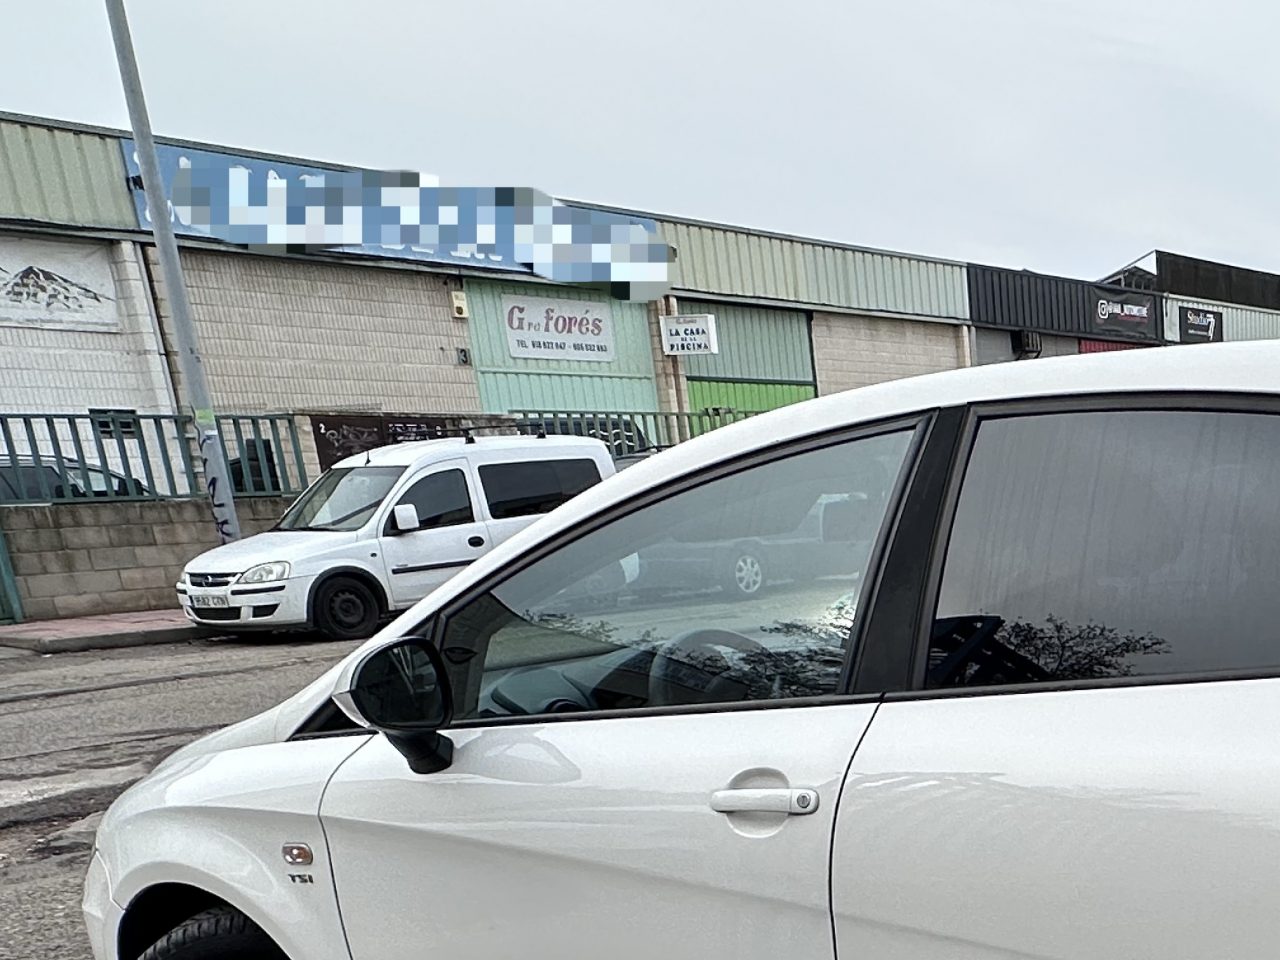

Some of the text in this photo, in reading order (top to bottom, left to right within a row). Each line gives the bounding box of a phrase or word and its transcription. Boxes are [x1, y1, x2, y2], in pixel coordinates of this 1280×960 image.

[544, 308, 603, 336] forés
[669, 327, 706, 337] LA CASA
[670, 342, 709, 351] PISCINA
[460, 348, 468, 364] 3
